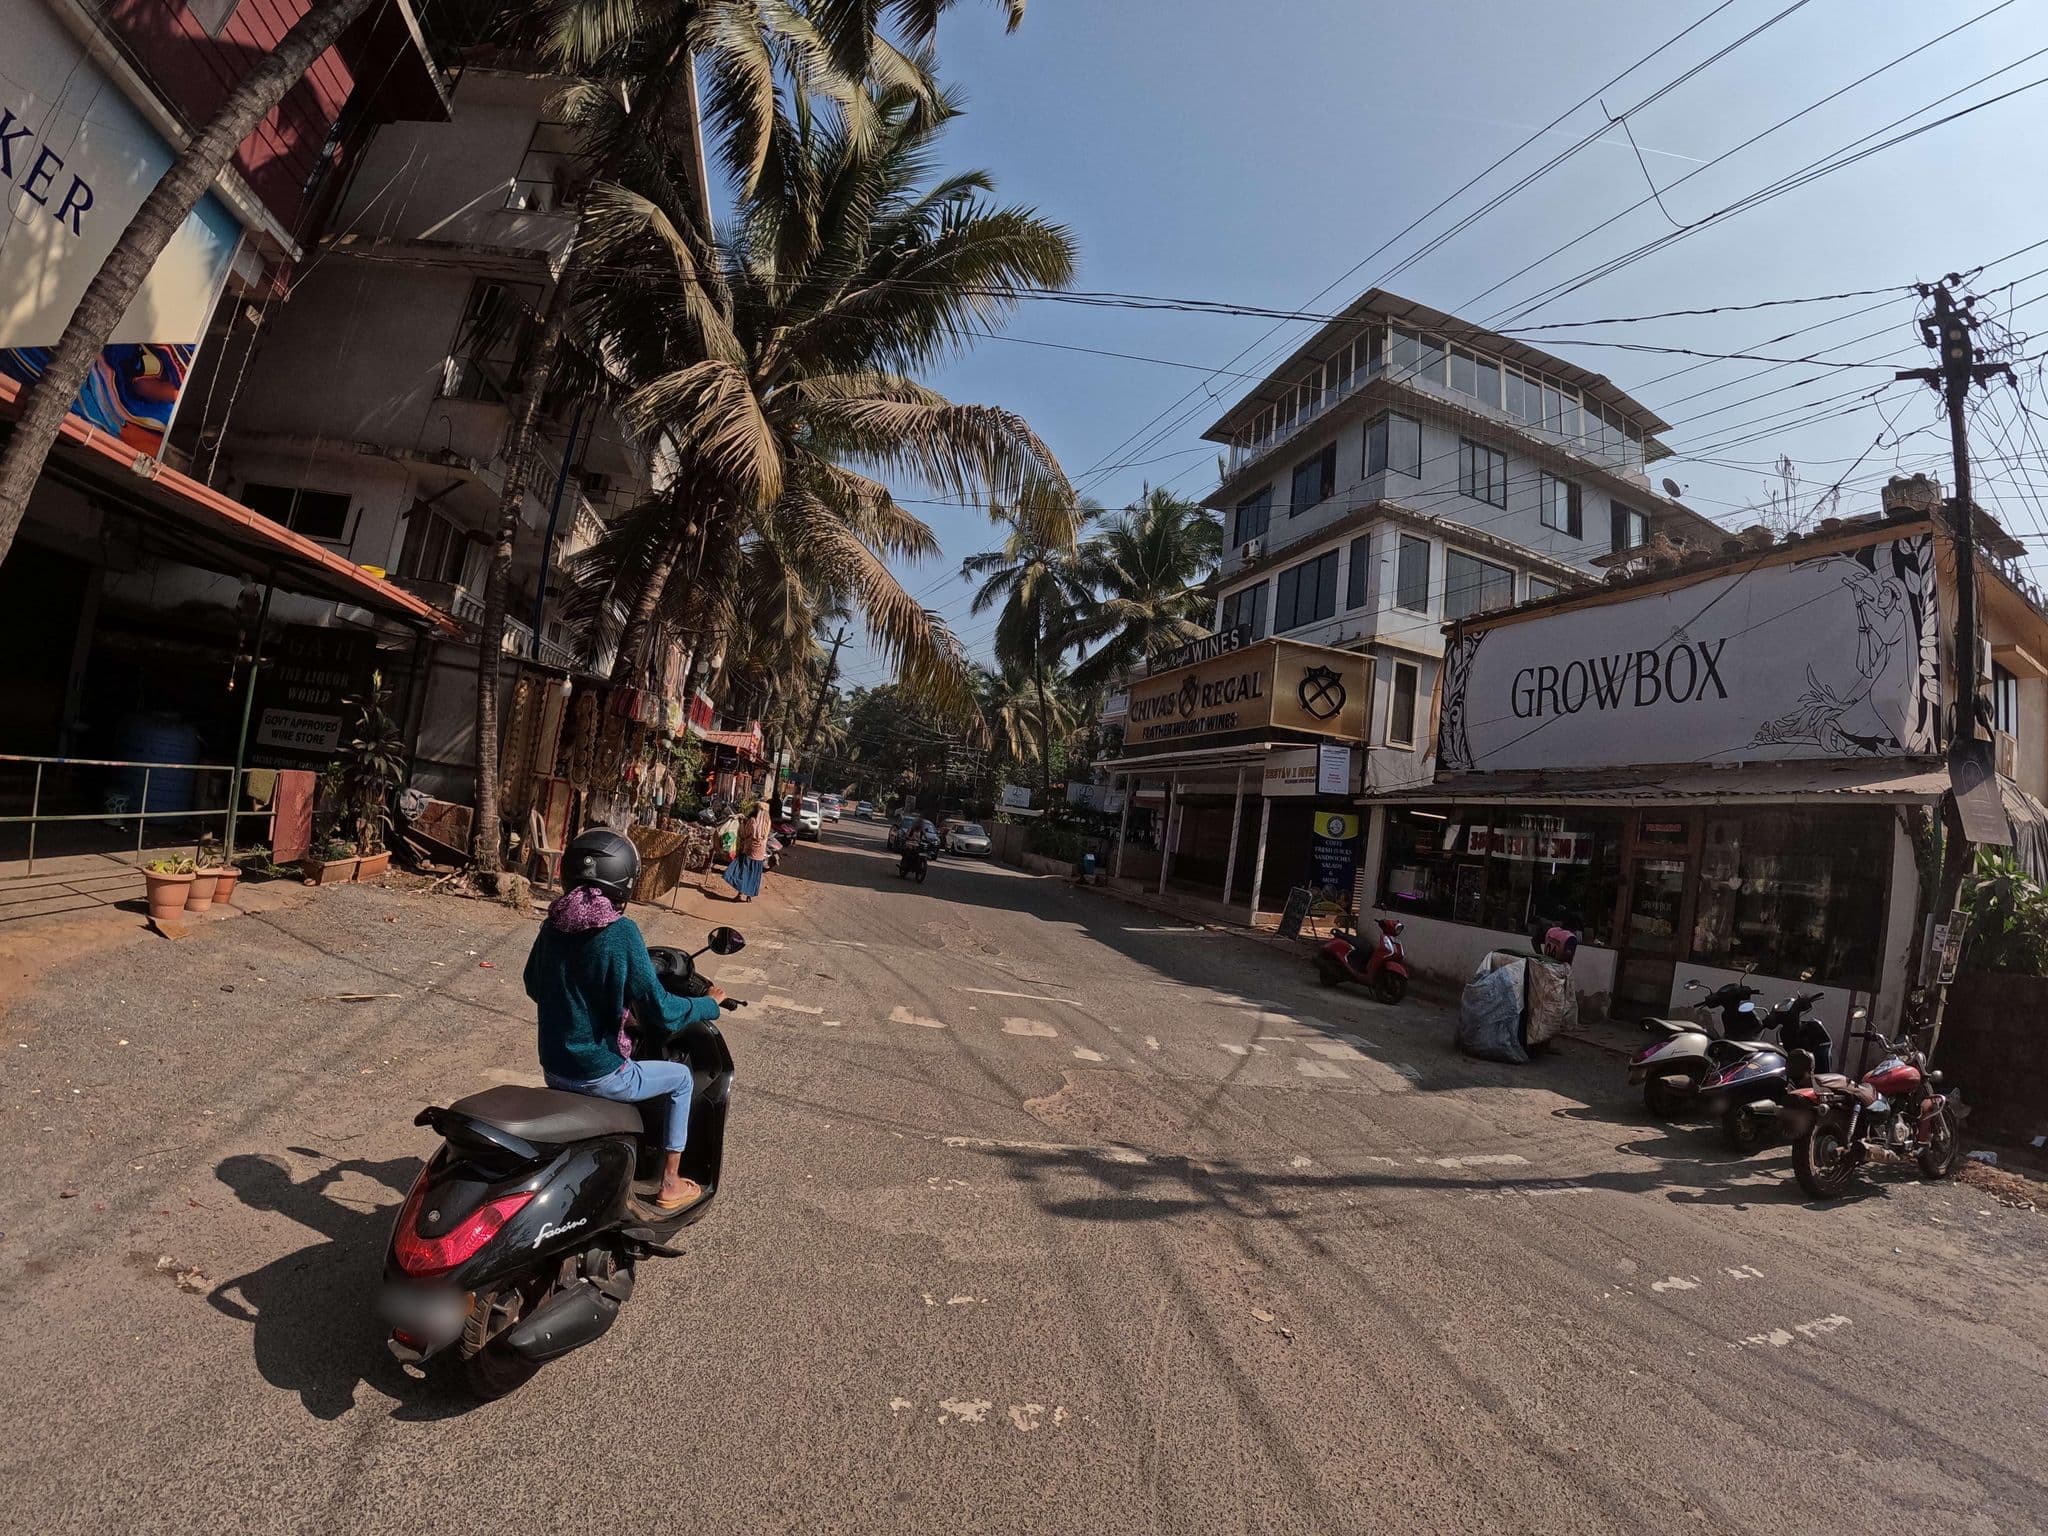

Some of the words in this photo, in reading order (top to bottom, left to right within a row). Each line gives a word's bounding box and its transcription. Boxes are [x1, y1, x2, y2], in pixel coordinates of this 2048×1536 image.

[0, 107, 94, 237] KER
[1192, 629, 1240, 662] WINES
[1511, 637, 1728, 719] GROWBOX
[288, 687, 331, 704] WORLD
[1131, 691, 1176, 722] CHIVAS
[1201, 672, 1263, 708] REGAL
[291, 718, 338, 732] APPROVED
[1206, 712, 1238, 732] WINES
[271, 728, 295, 741] WINE
[295, 732, 326, 745] STORE
